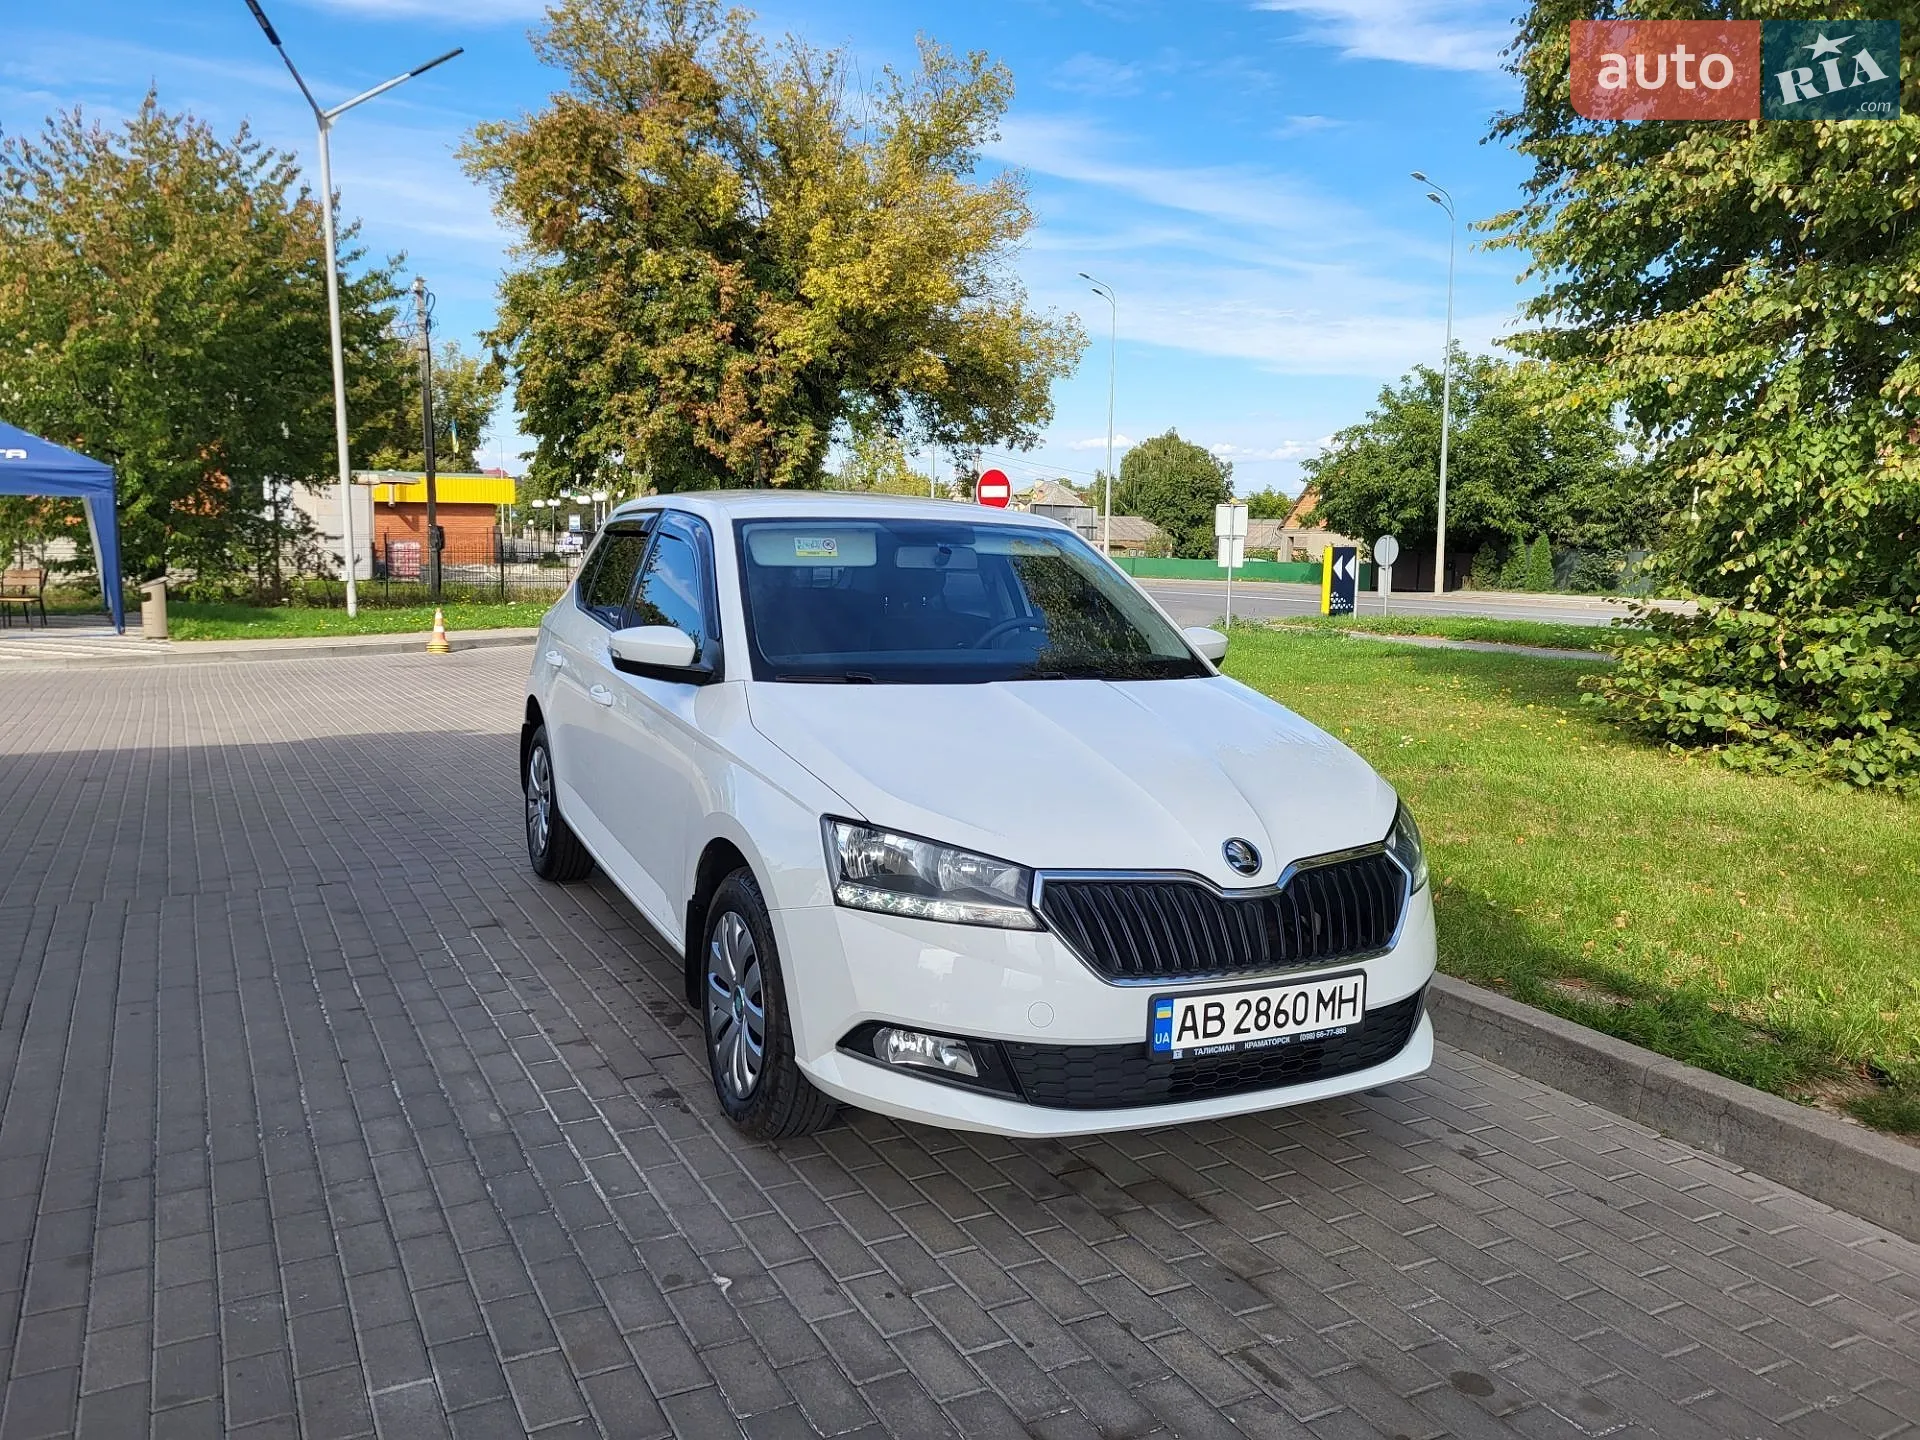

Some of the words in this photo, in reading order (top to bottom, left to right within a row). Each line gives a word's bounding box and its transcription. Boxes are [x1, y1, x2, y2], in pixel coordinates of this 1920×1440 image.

[1176, 1002, 1226, 1042] AB
[1233, 991, 1309, 1035] 2860
[1315, 983, 1358, 1023] MH
[1155, 1033, 1170, 1045] UA
[1194, 1044, 1235, 1056] ТАЛИСМАН
[1244, 1036, 1290, 1050] КРАМАТОРСК
